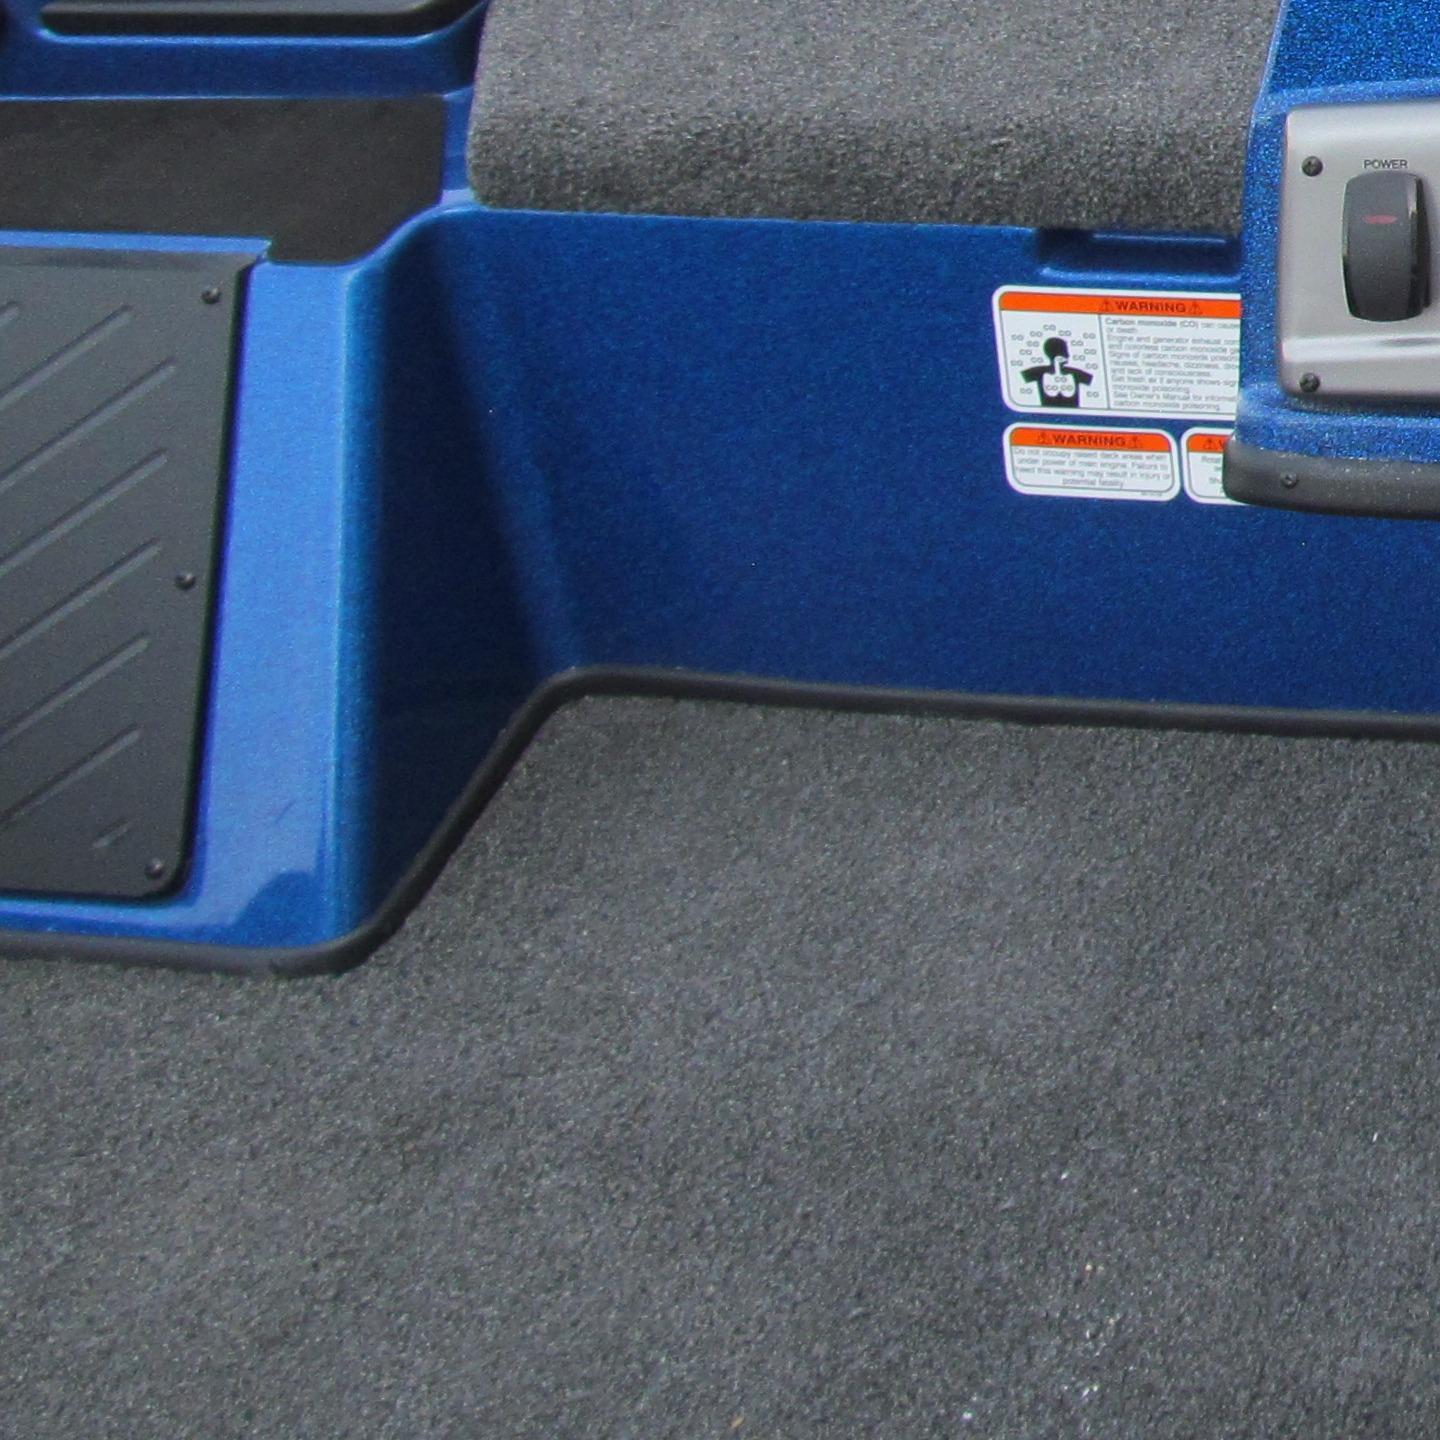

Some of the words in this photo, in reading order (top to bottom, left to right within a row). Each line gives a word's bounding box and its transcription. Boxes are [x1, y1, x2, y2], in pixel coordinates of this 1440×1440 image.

[1363, 159, 1408, 170] POWER
[1115, 301, 1187, 313] WARNING
[1053, 434, 1126, 447] WARNING
